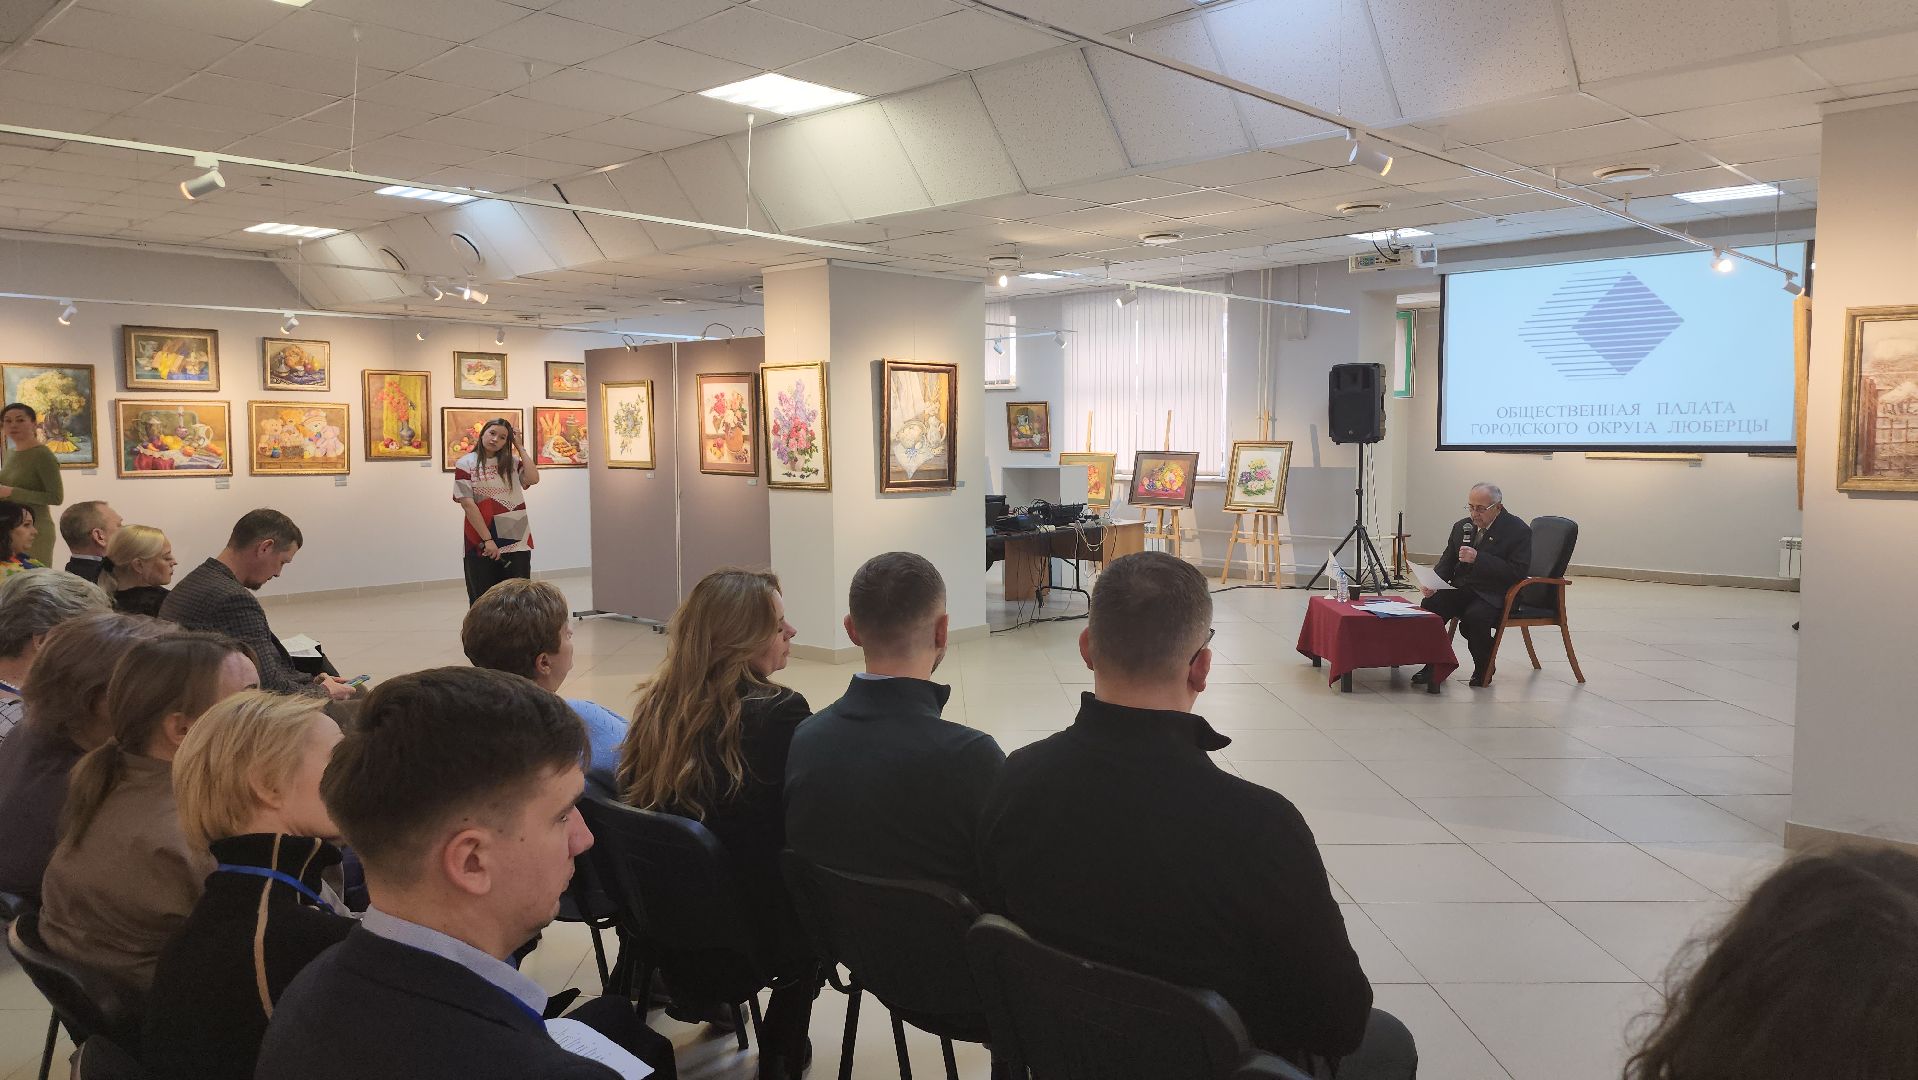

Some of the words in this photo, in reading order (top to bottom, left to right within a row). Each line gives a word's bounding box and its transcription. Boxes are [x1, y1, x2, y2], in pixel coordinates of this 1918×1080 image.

[1496, 403, 1641, 420] ОБЩЕСТВЕННАЯ
[1656, 401, 1736, 415] ПАЛАТА
[1471, 422, 1578, 437] ГОРОДСКОГО
[1587, 421, 1657, 434] ОКРУГА
[1667, 419, 1769, 434] ЛЮБЕРЦЫ
